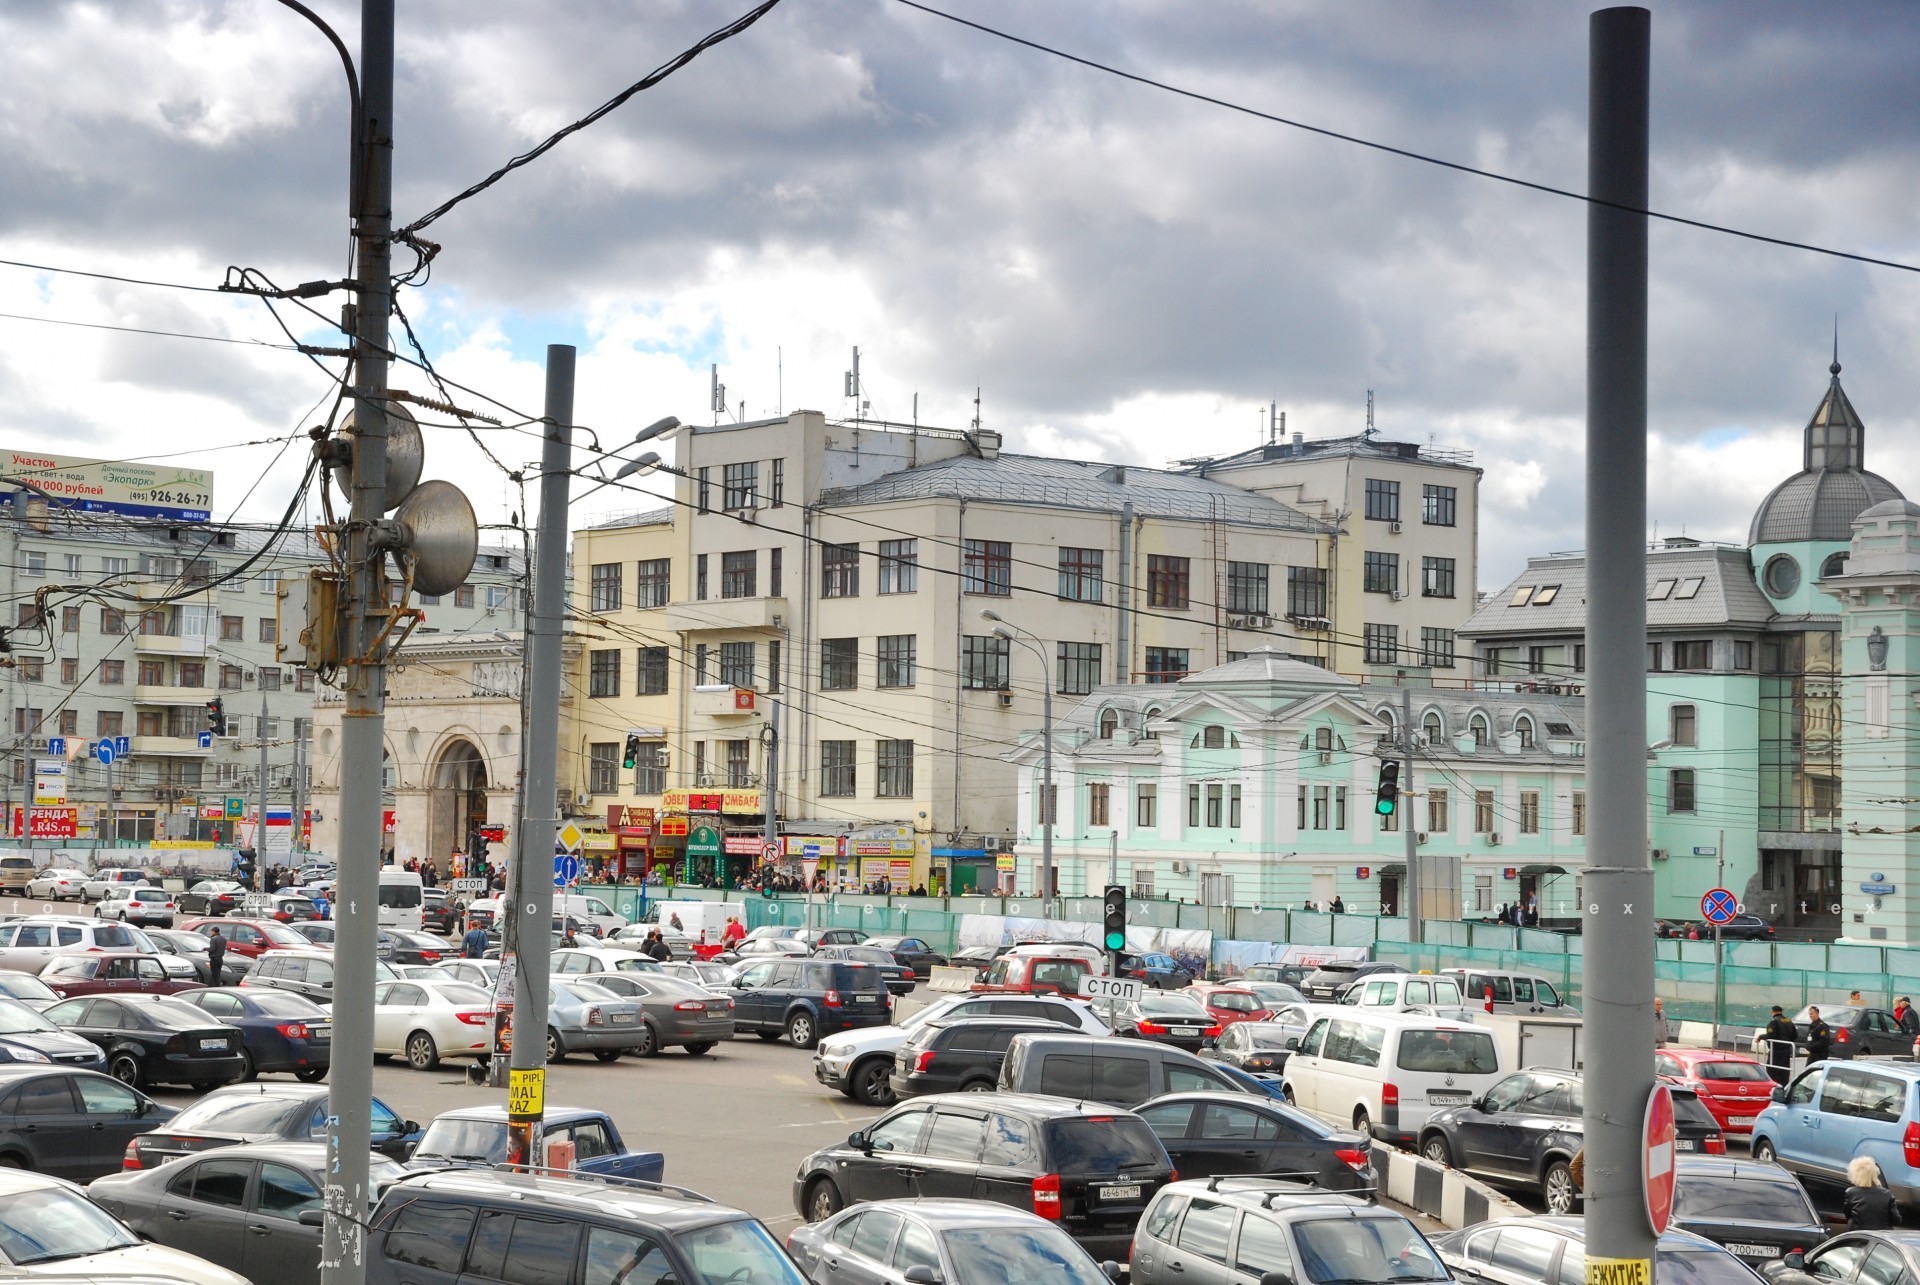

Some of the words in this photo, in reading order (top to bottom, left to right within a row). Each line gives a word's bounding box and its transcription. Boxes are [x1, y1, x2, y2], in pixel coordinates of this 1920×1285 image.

[13, 454, 56, 468] Участок
[102, 464, 129, 474] Дачный
[130, 468, 156, 476] поселок
[103, 472, 154, 487] «Экопарк»
[44, 481, 63, 491] 000
[65, 483, 104, 495] рублей
[130, 491, 148, 502] (495)
[151, 490, 209, 506] 926-26-77
[22, 809, 69, 820] РЕНДА
[457, 880, 483, 889] СТОП
[249, 895, 268, 905] СТОП
[1088, 979, 1133, 998] СТОП
[523, 1074, 541, 1082] PIPL
[511, 1086, 536, 1099] MAL
[1102, 1187, 1129, 1198] А646ТМ
[1727, 1244, 1763, 1256] К700УН
